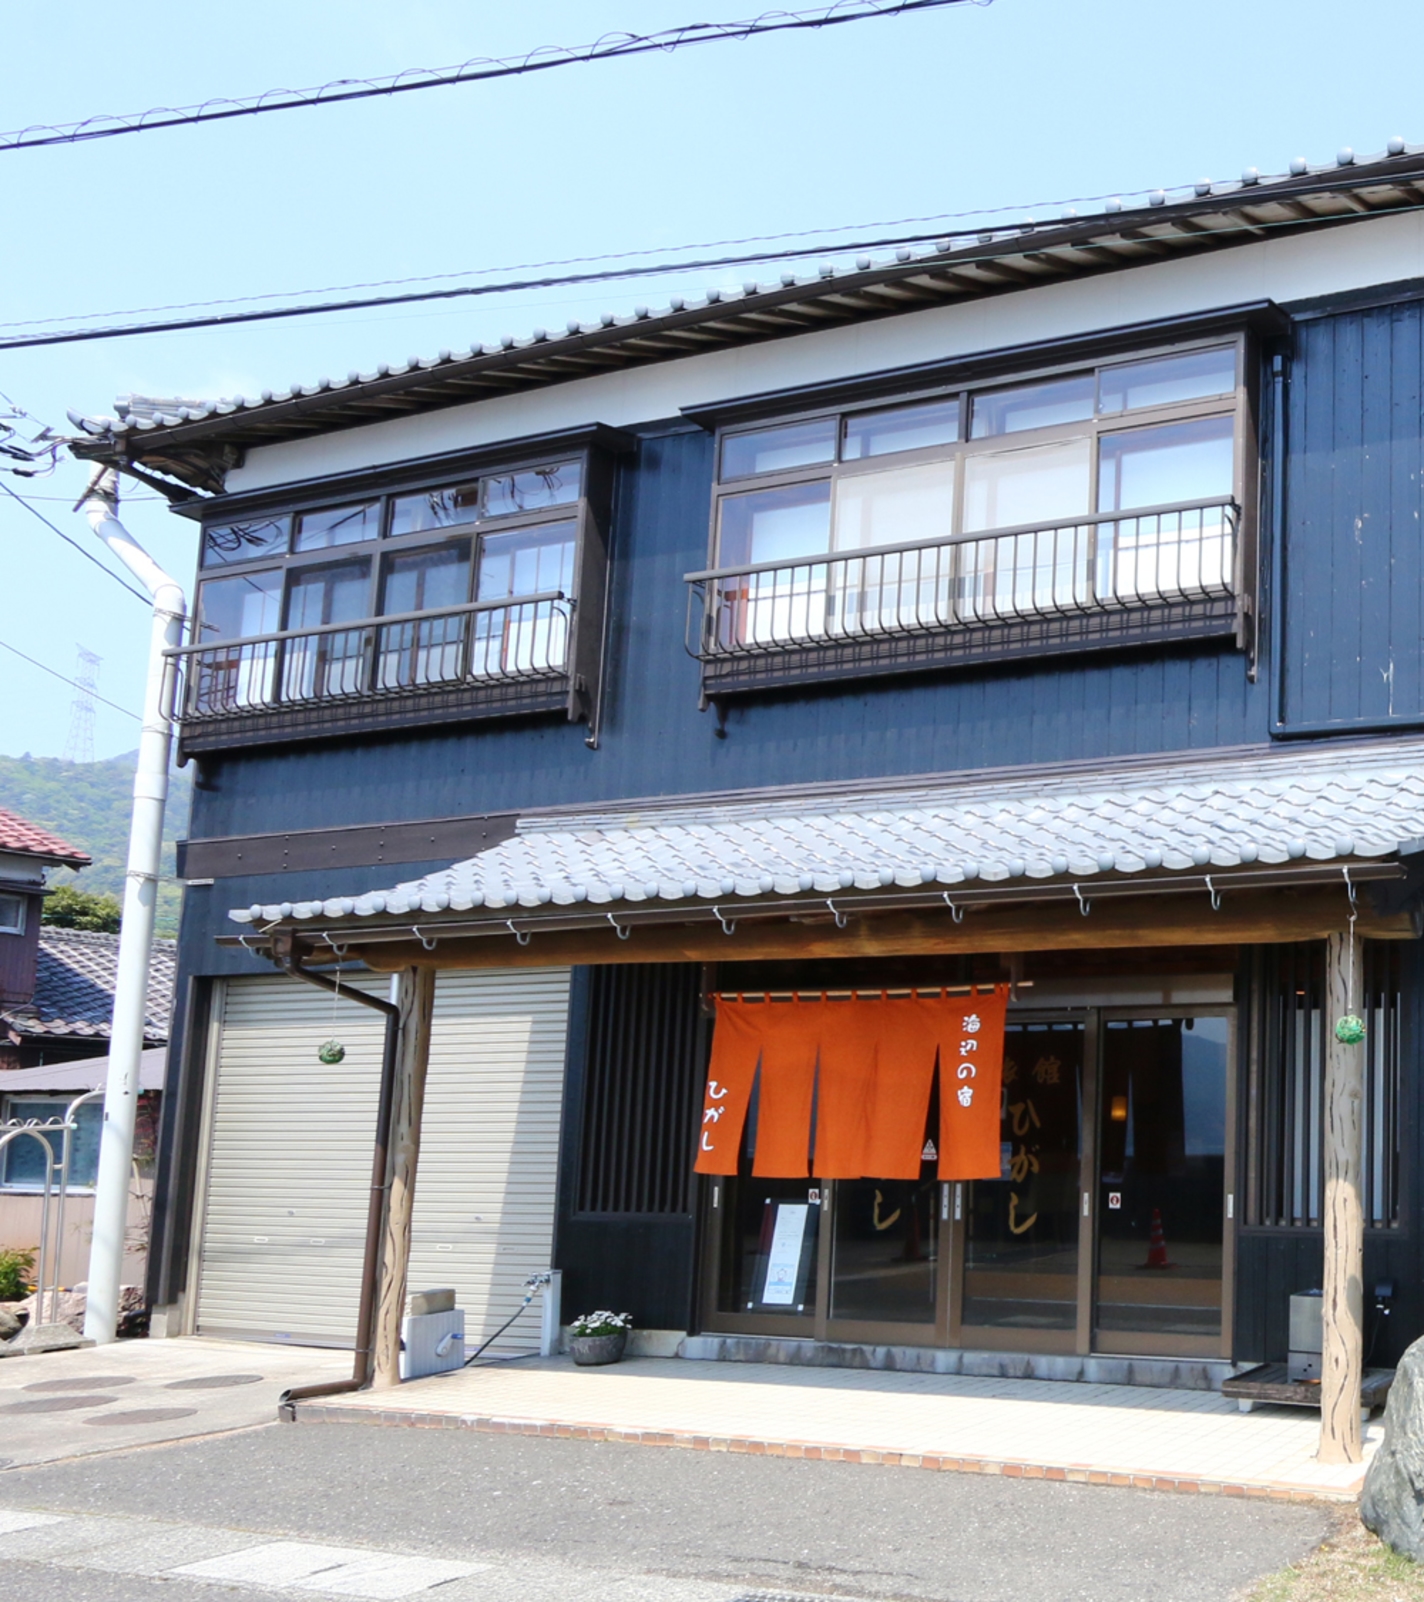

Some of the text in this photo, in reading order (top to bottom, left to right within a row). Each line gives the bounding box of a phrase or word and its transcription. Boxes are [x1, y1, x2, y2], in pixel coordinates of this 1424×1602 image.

[957, 1014, 981, 1107] 海辺の宿
[702, 1081, 728, 1151] ひがし
[1008, 1099, 1041, 1234] ひがし
